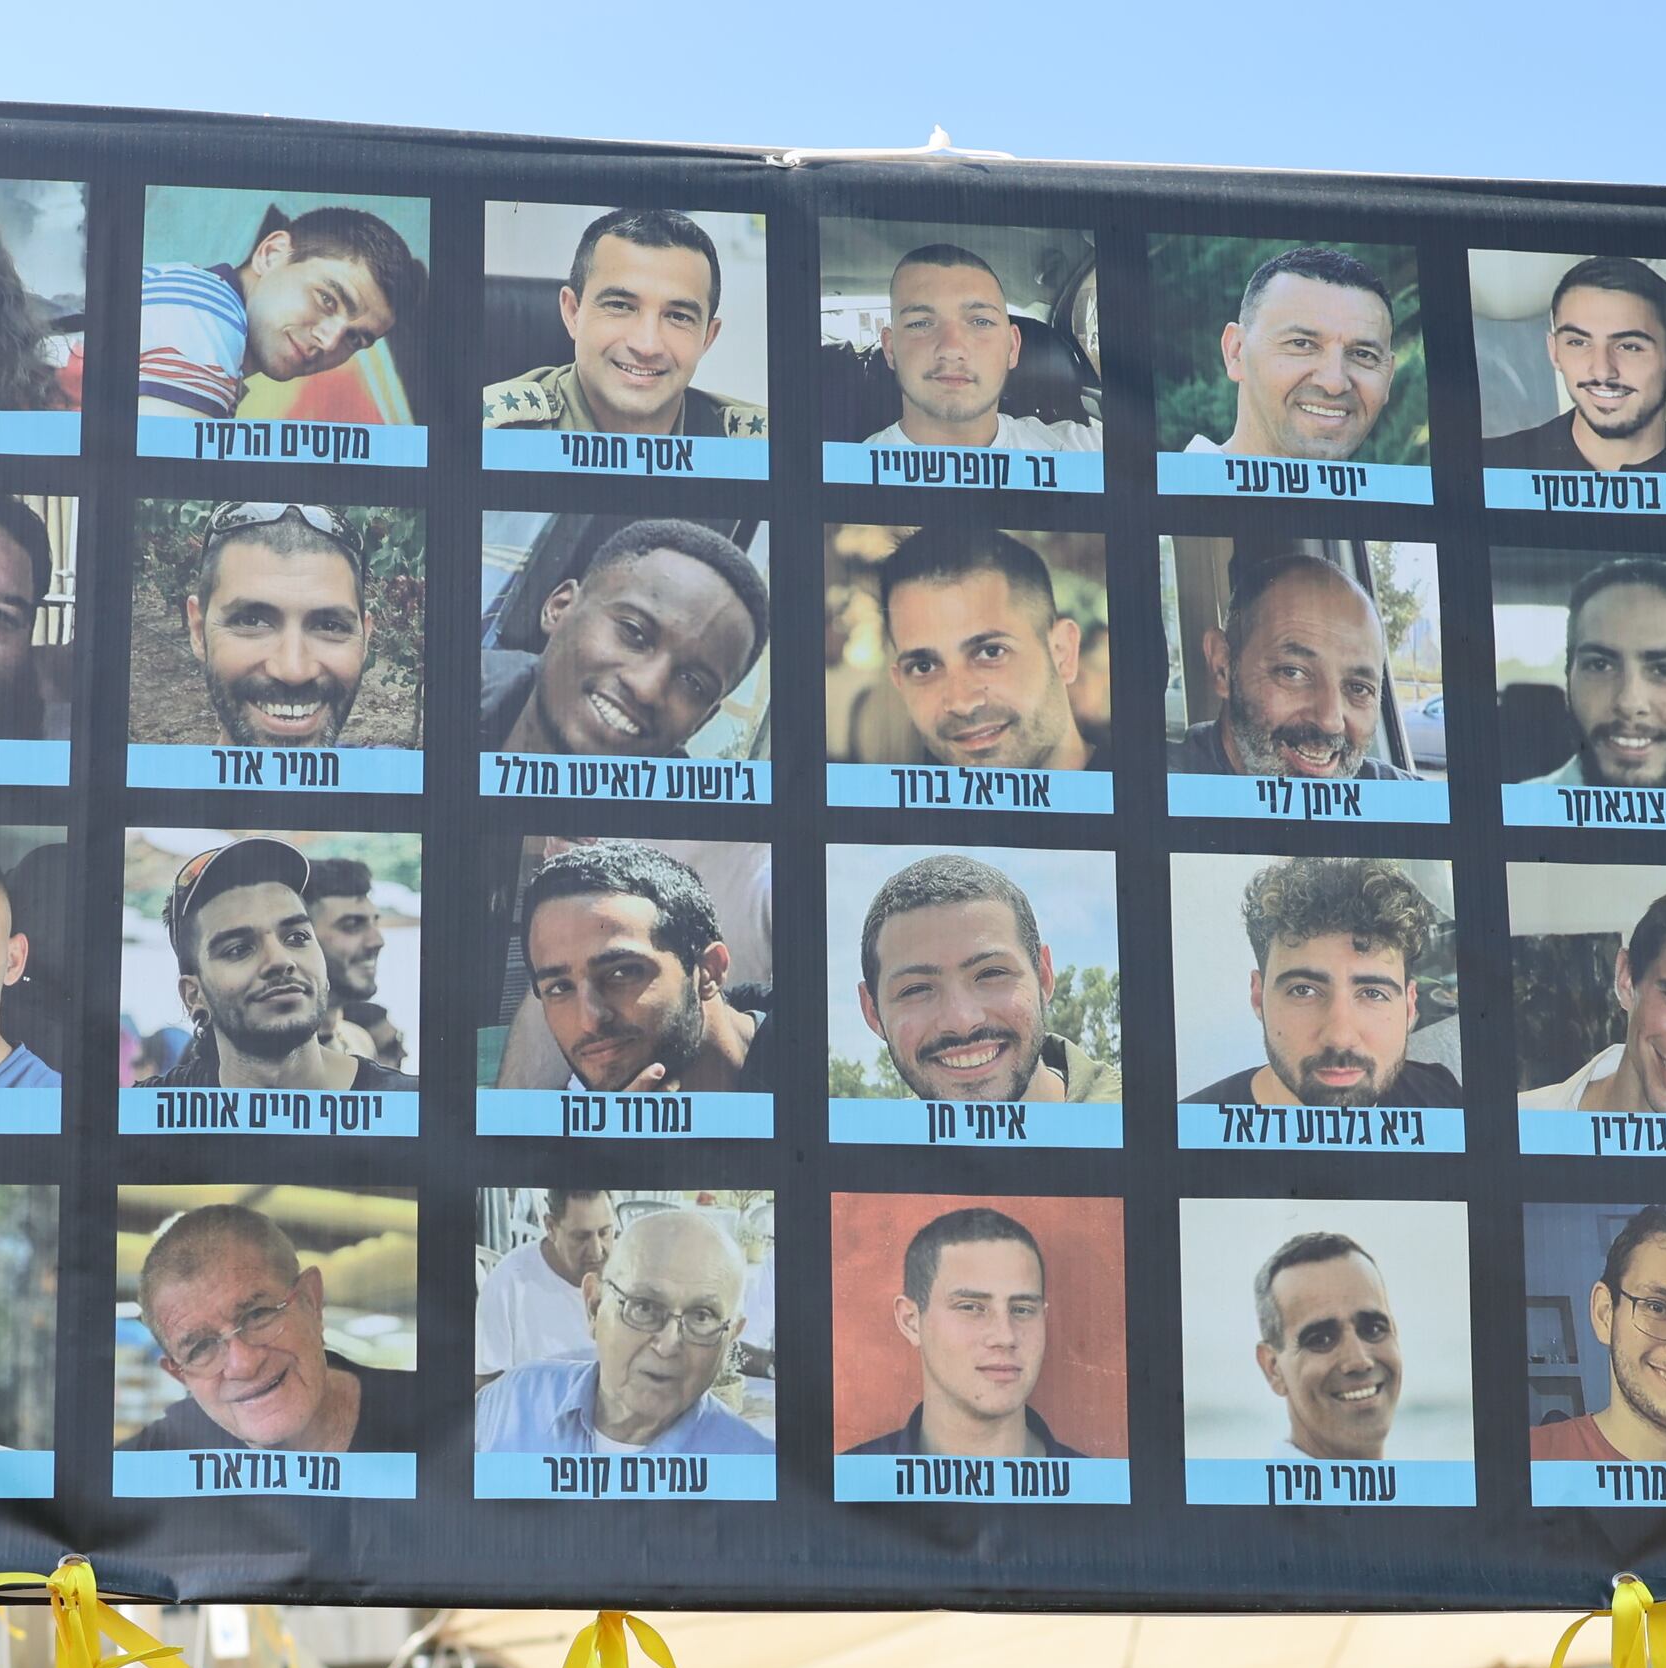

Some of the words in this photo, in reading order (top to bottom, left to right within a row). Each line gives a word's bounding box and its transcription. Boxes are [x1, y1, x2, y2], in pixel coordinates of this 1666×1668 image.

[194, 422, 271, 460] הרקין
[280, 423, 370, 463] מקסים
[560, 434, 628, 469] חממי
[636, 437, 694, 475] אסף
[869, 449, 1010, 488] קופרשטיין
[1025, 455, 1058, 488] בר
[1225, 459, 1310, 494] שרעבי
[1317, 464, 1367, 497] יוסי
[1531, 472, 1661, 510] ברסלבסקי
[211, 749, 264, 785] אדר
[272, 751, 339, 787] תמיר
[495, 755, 559, 795] מולל
[567, 760, 657, 798] לואיטו
[666, 761, 756, 801] ג'ושוע
[890, 769, 951, 807] ברוך
[958, 767, 1051, 808] אוריאל
[1256, 777, 1293, 814] לוי
[1301, 782, 1362, 819] איתן
[1557, 788, 1666, 826] צנגאוקר
[156, 1091, 239, 1128] אוחנה
[249, 1093, 311, 1129] חיים
[320, 1094, 382, 1135] יוסף
[560, 1095, 606, 1136] כהן
[615, 1096, 692, 1133] נמרוד
[926, 1103, 956, 1144] חן
[964, 1104, 1027, 1140] איתי
[1218, 1105, 1287, 1143] דלאל
[1295, 1108, 1373, 1145] גלבוע
[1379, 1110, 1425, 1146] גיא
[188, 1453, 287, 1490] גודארד
[297, 1455, 341, 1491] מני
[543, 1456, 611, 1498] קופר
[620, 1456, 708, 1493] עמירם
[895, 1458, 995, 1497] נאוטרה
[1002, 1460, 1070, 1497] עומר
[1265, 1464, 1322, 1504] מירן
[1330, 1465, 1396, 1502] עמרי
